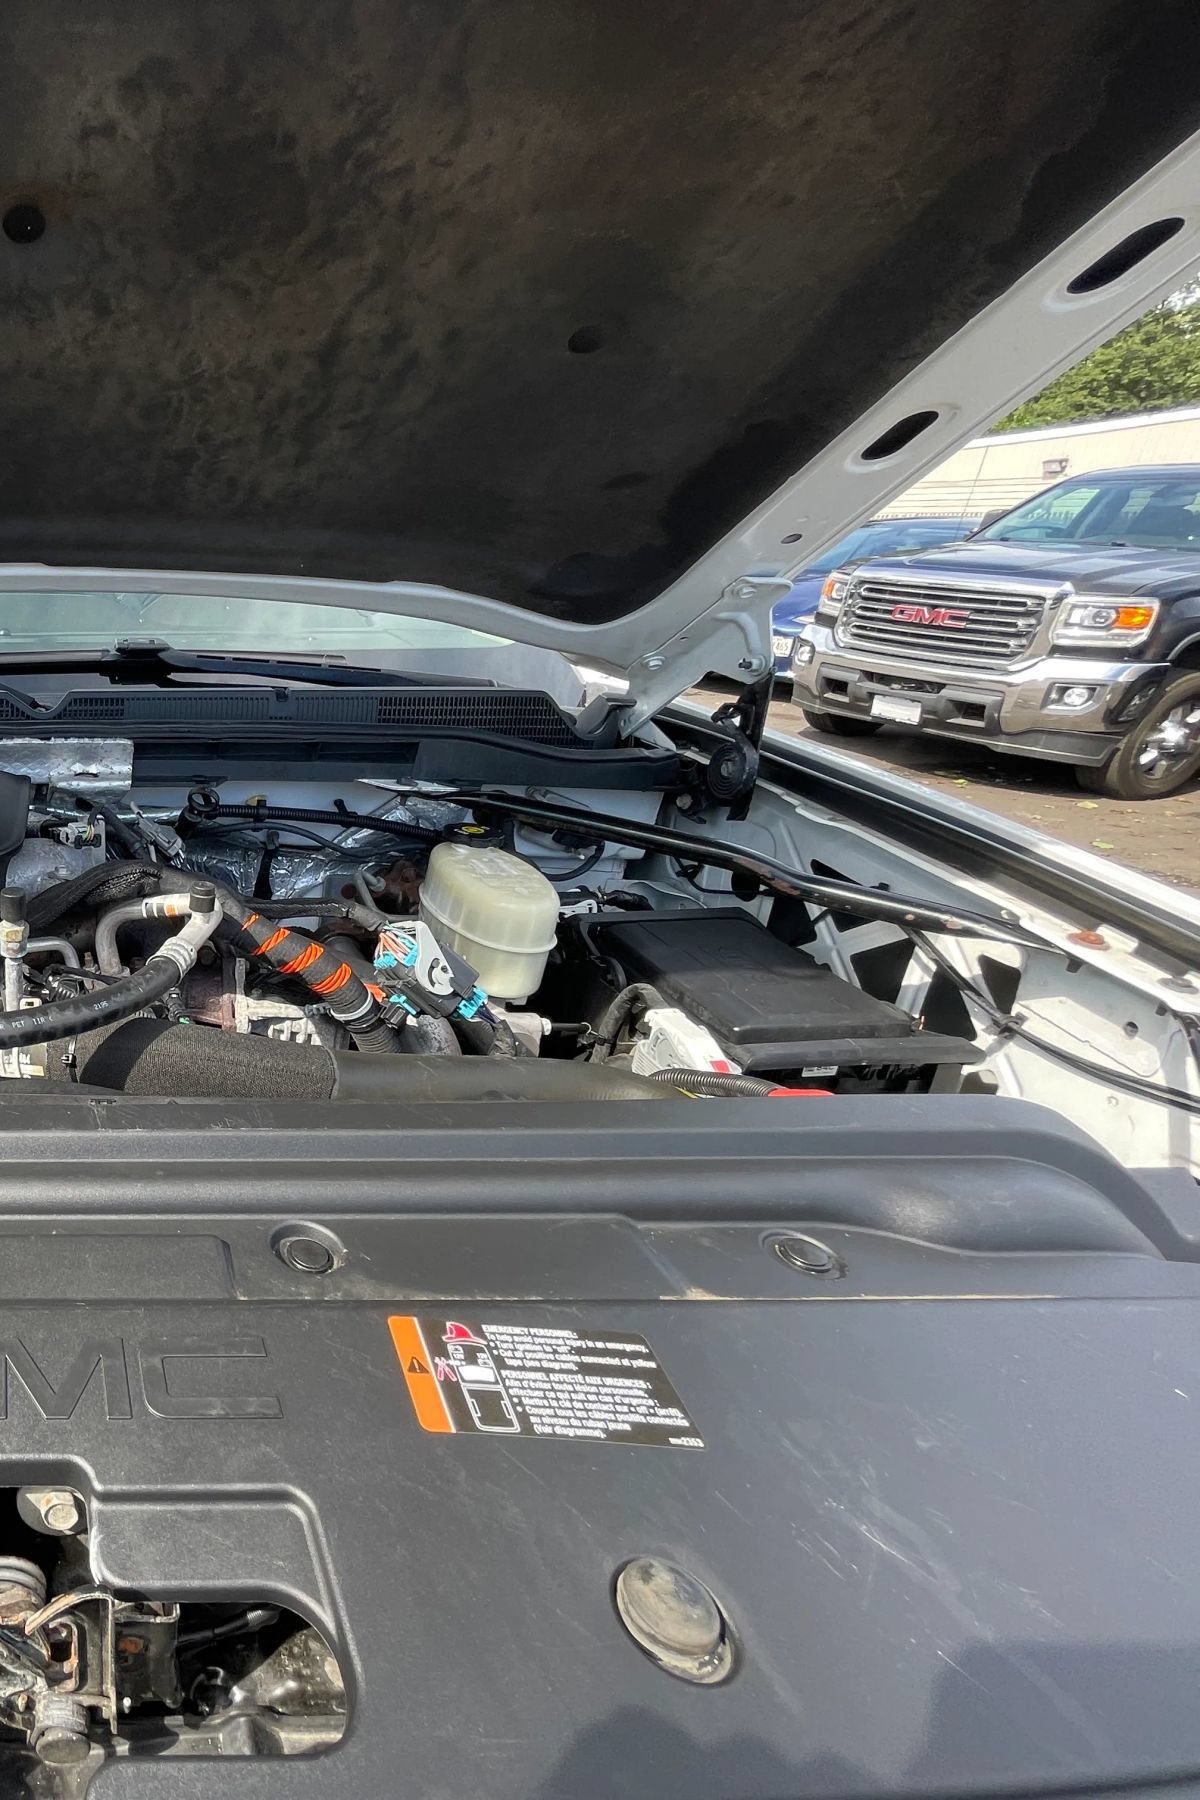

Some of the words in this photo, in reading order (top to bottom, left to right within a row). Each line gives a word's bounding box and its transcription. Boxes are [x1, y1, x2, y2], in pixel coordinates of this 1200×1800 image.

[891, 604, 971, 628] GMC
[482, 1324, 528, 1333] EMERGENCY
[529, 1328, 577, 1337] PERSONNEL:
[514, 1343, 542, 1351] ignition
[581, 1356, 621, 1364] connected
[501, 1370, 548, 1379] PERSONNEL
[547, 1372, 583, 1382] AFFECTÉ
[602, 1378, 646, 1387] URGENCES
[508, 1388, 544, 1396] effectuer
[584, 1402, 614, 1410] contact
[525, 1407, 555, 1415] Couper
[646, 1416, 689, 1425] connectés
